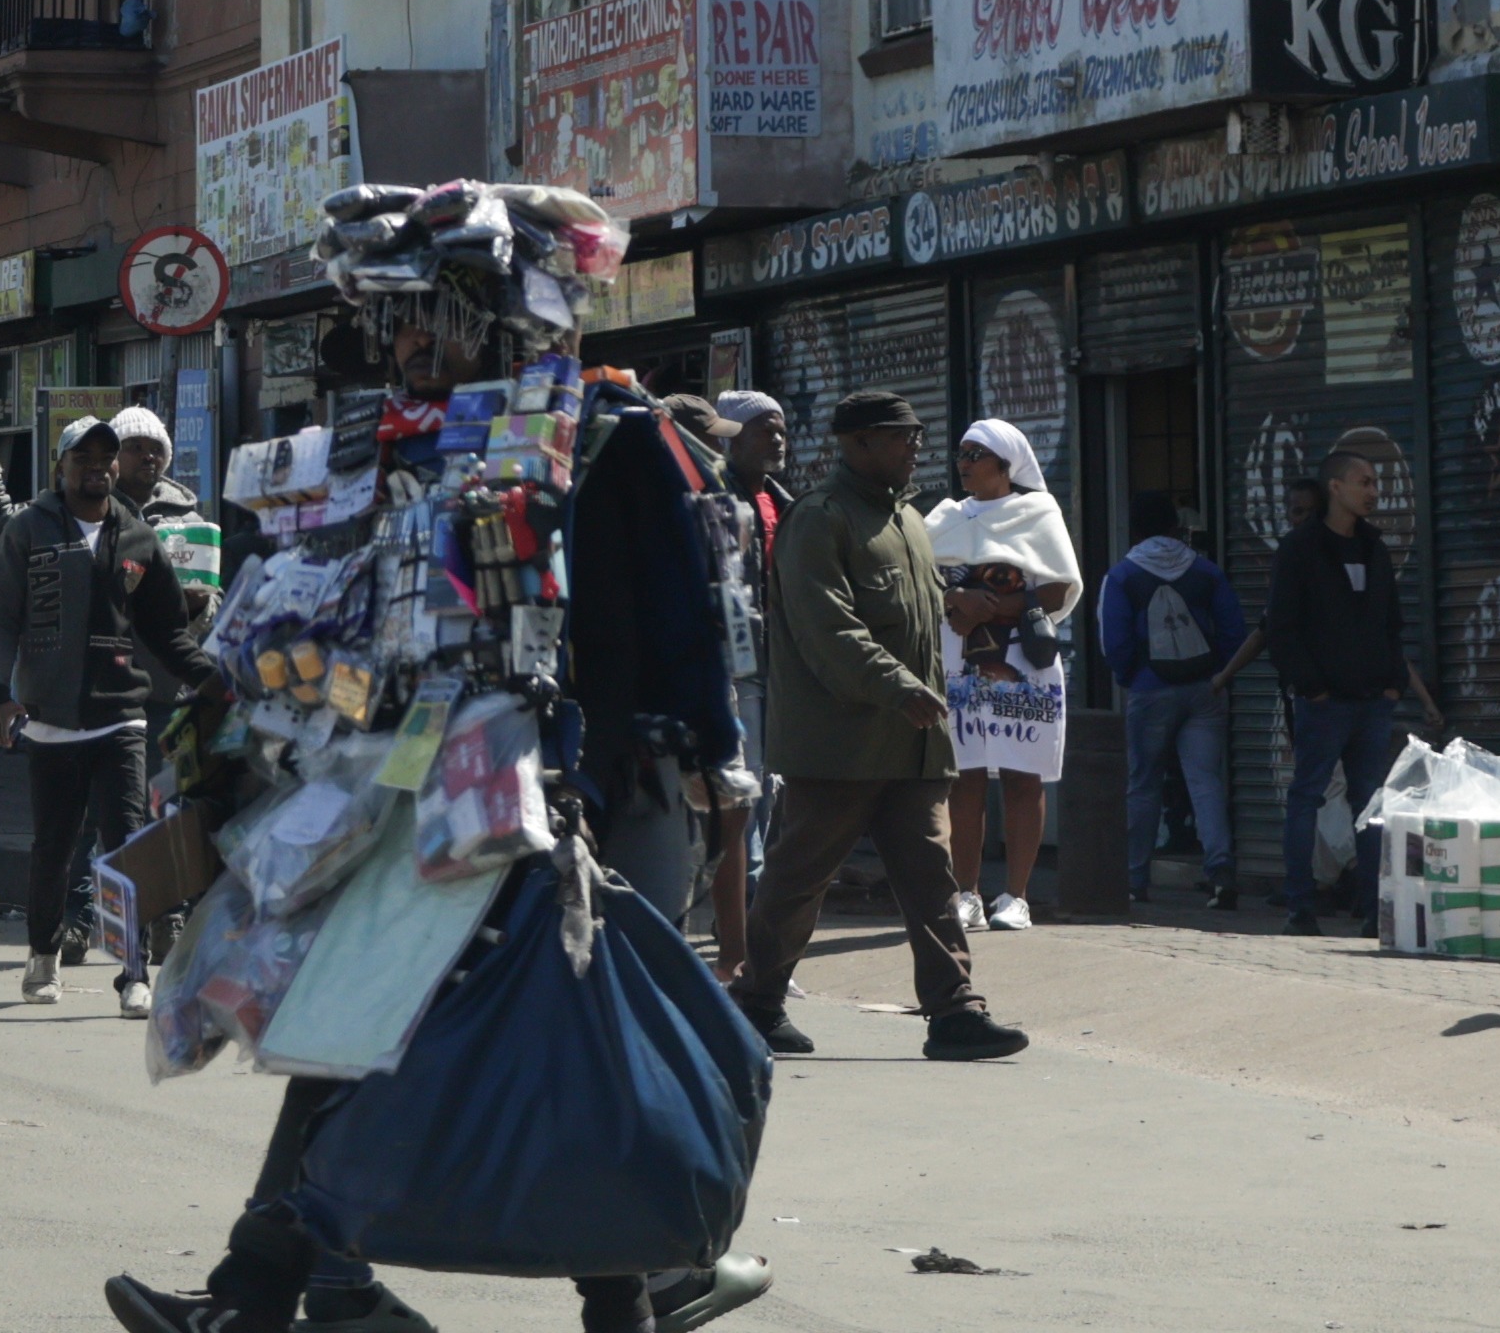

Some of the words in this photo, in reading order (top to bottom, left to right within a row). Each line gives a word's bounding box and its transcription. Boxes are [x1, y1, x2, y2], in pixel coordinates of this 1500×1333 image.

[539, 13, 587, 70] MRIDHA
[712, 0, 819, 65] REPAIR
[199, 81, 238, 146] RAIKA
[240, 39, 340, 132] SUPERMARKET
[714, 70, 756, 86] DONE
[762, 69, 810, 86] HERE
[710, 90, 755, 112] HARD
[760, 90, 816, 112] WARE
[710, 116, 742, 133] SOFT
[758, 115, 808, 133] WARE
[1345, 95, 1409, 180] School
[1416, 95, 1479, 166] Wear
[703, 242, 745, 292] BIG
[751, 229, 807, 283] CITY
[810, 205, 891, 271] STORE
[907, 206, 937, 252] 34
[992, 703, 1057, 723] BEFORE
[1003, 691, 1055, 711] STAND
